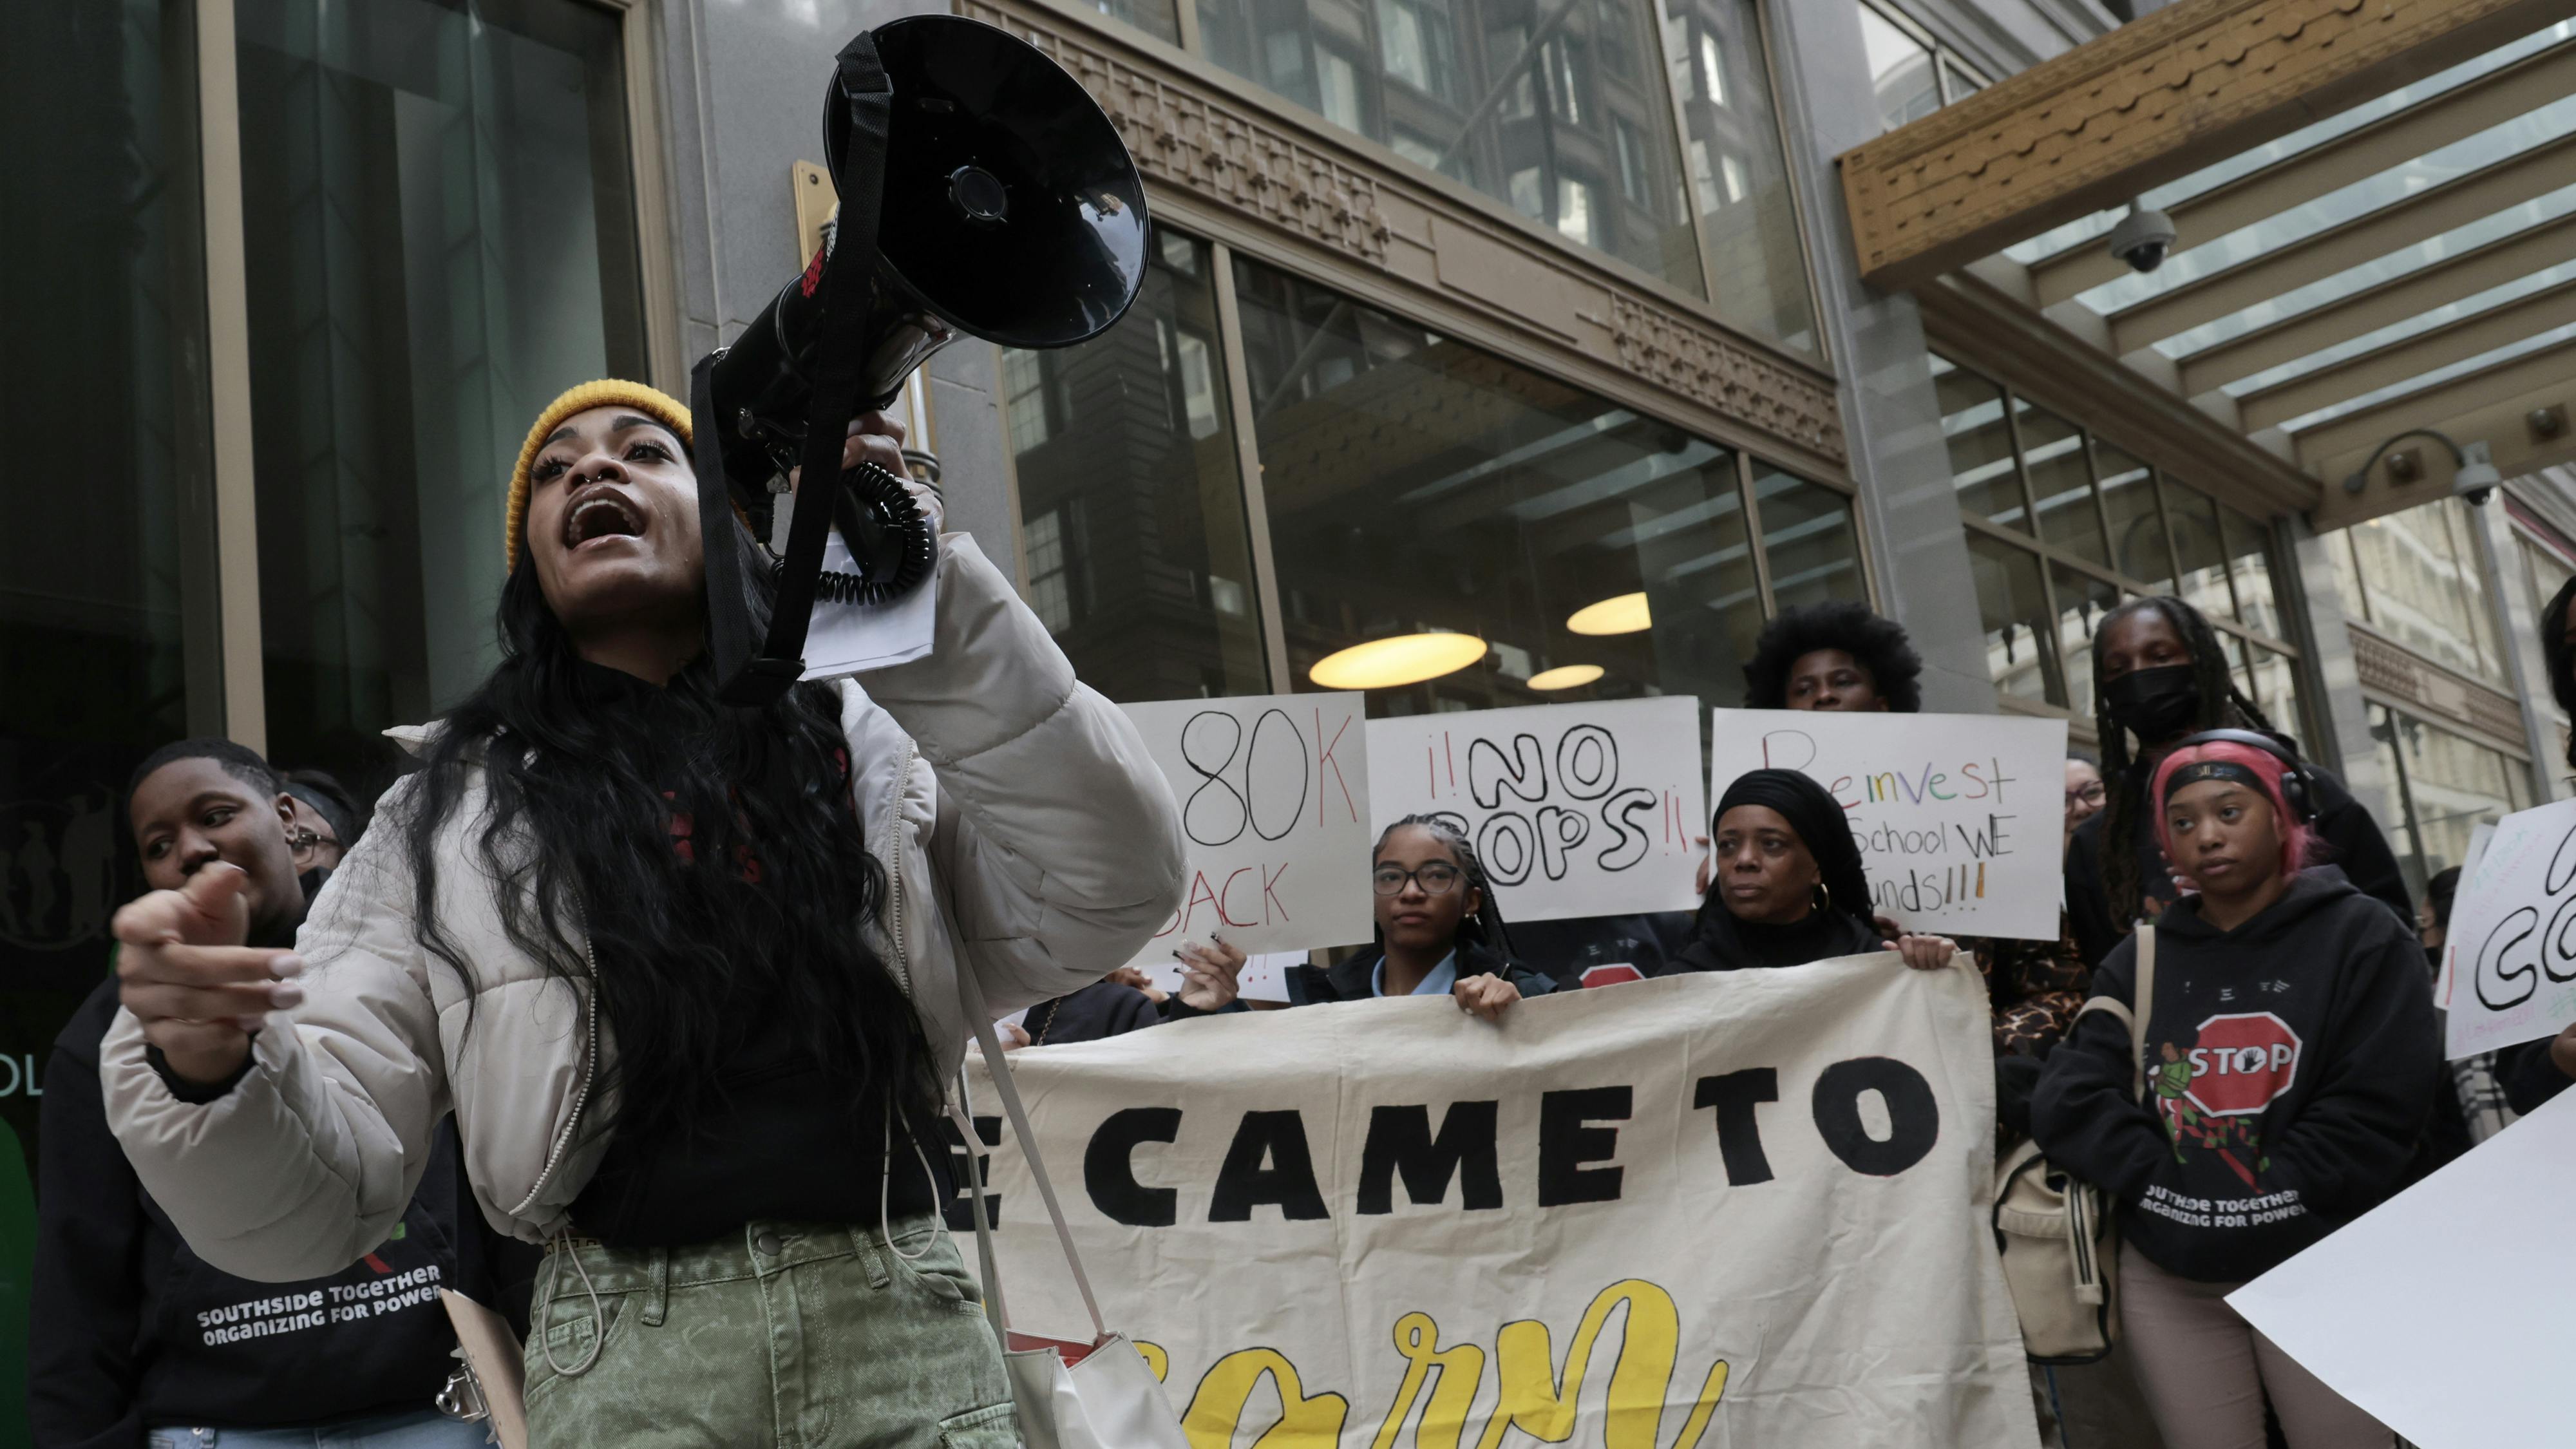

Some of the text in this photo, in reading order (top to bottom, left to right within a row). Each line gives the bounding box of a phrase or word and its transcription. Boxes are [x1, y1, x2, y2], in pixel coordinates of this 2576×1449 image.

[1861, 861, 1985, 916] unds!!!
[1084, 1085, 1633, 1227] CAME
[1693, 1056, 1940, 1188] TO
[330, 1303, 370, 1323] FOR
